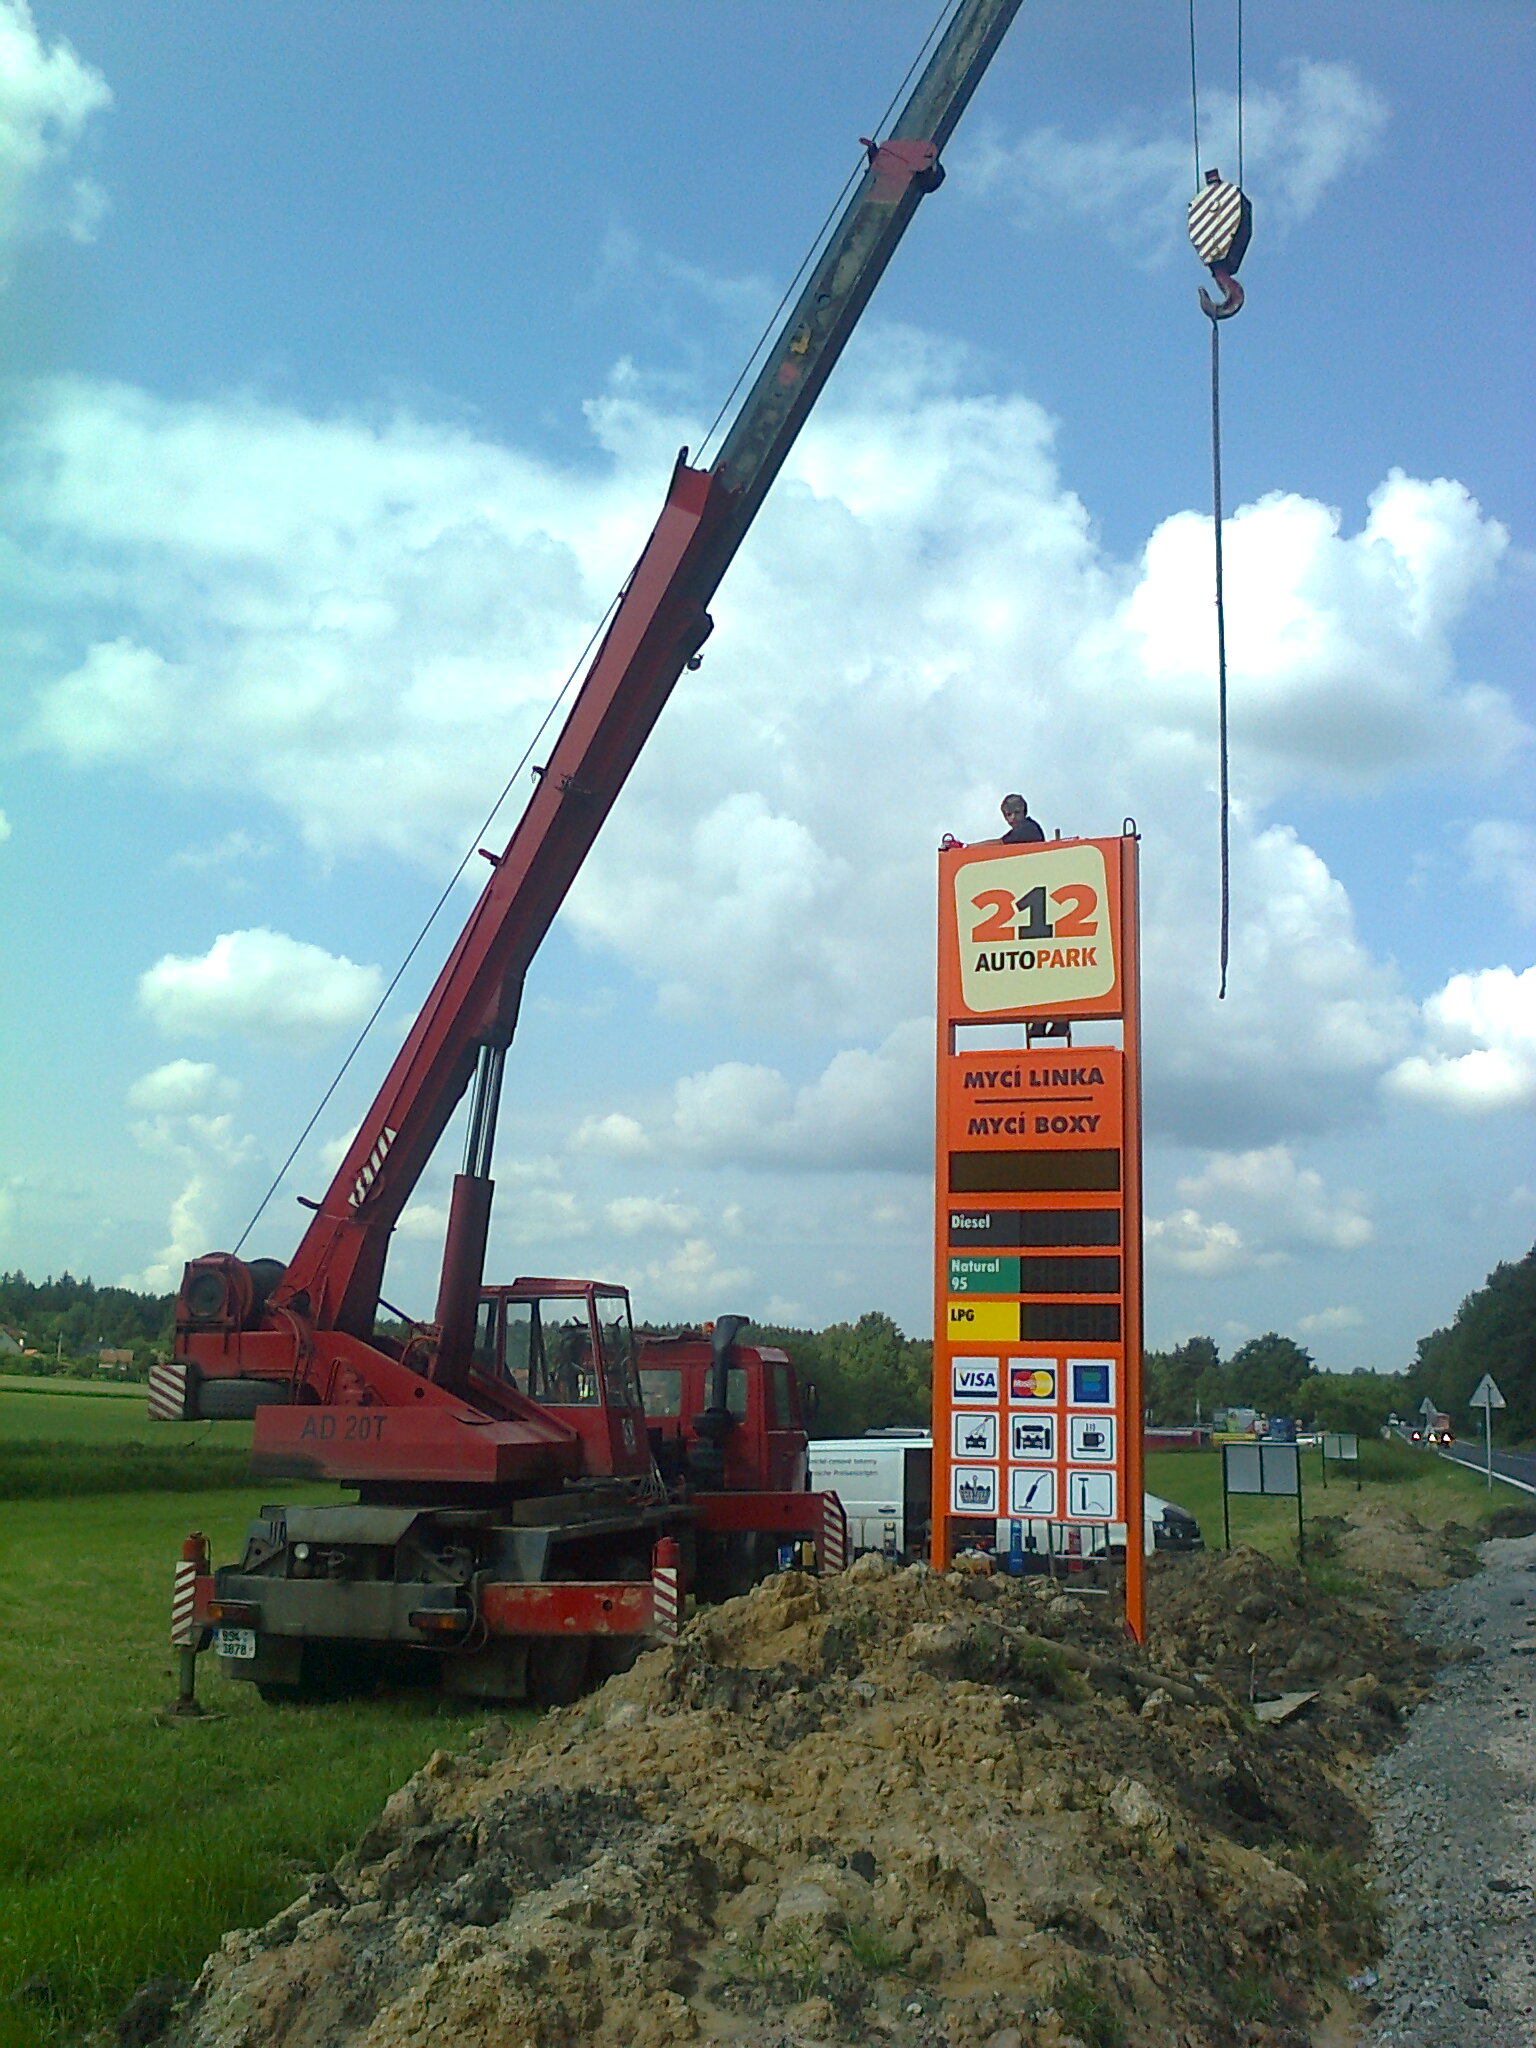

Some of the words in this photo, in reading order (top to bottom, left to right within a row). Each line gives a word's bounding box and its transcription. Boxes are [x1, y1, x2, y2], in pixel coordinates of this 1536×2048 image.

[970, 884, 1098, 942] 212
[974, 946, 1097, 972] AUTOPARK
[963, 1065, 1021, 1089] MYCÍ
[1029, 1067, 1105, 1087] LINKA
[967, 1111, 1025, 1135] MYCÍ
[1035, 1114, 1101, 1134] BOXY
[951, 1213, 991, 1229] Diesel
[951, 1258, 1000, 1273] Natural
[951, 1276, 968, 1291] 95
[951, 1308, 975, 1321] LPG
[959, 1372, 995, 1387] VISA
[300, 1415, 336, 1440] AD
[344, 1415, 388, 1441] 20T
